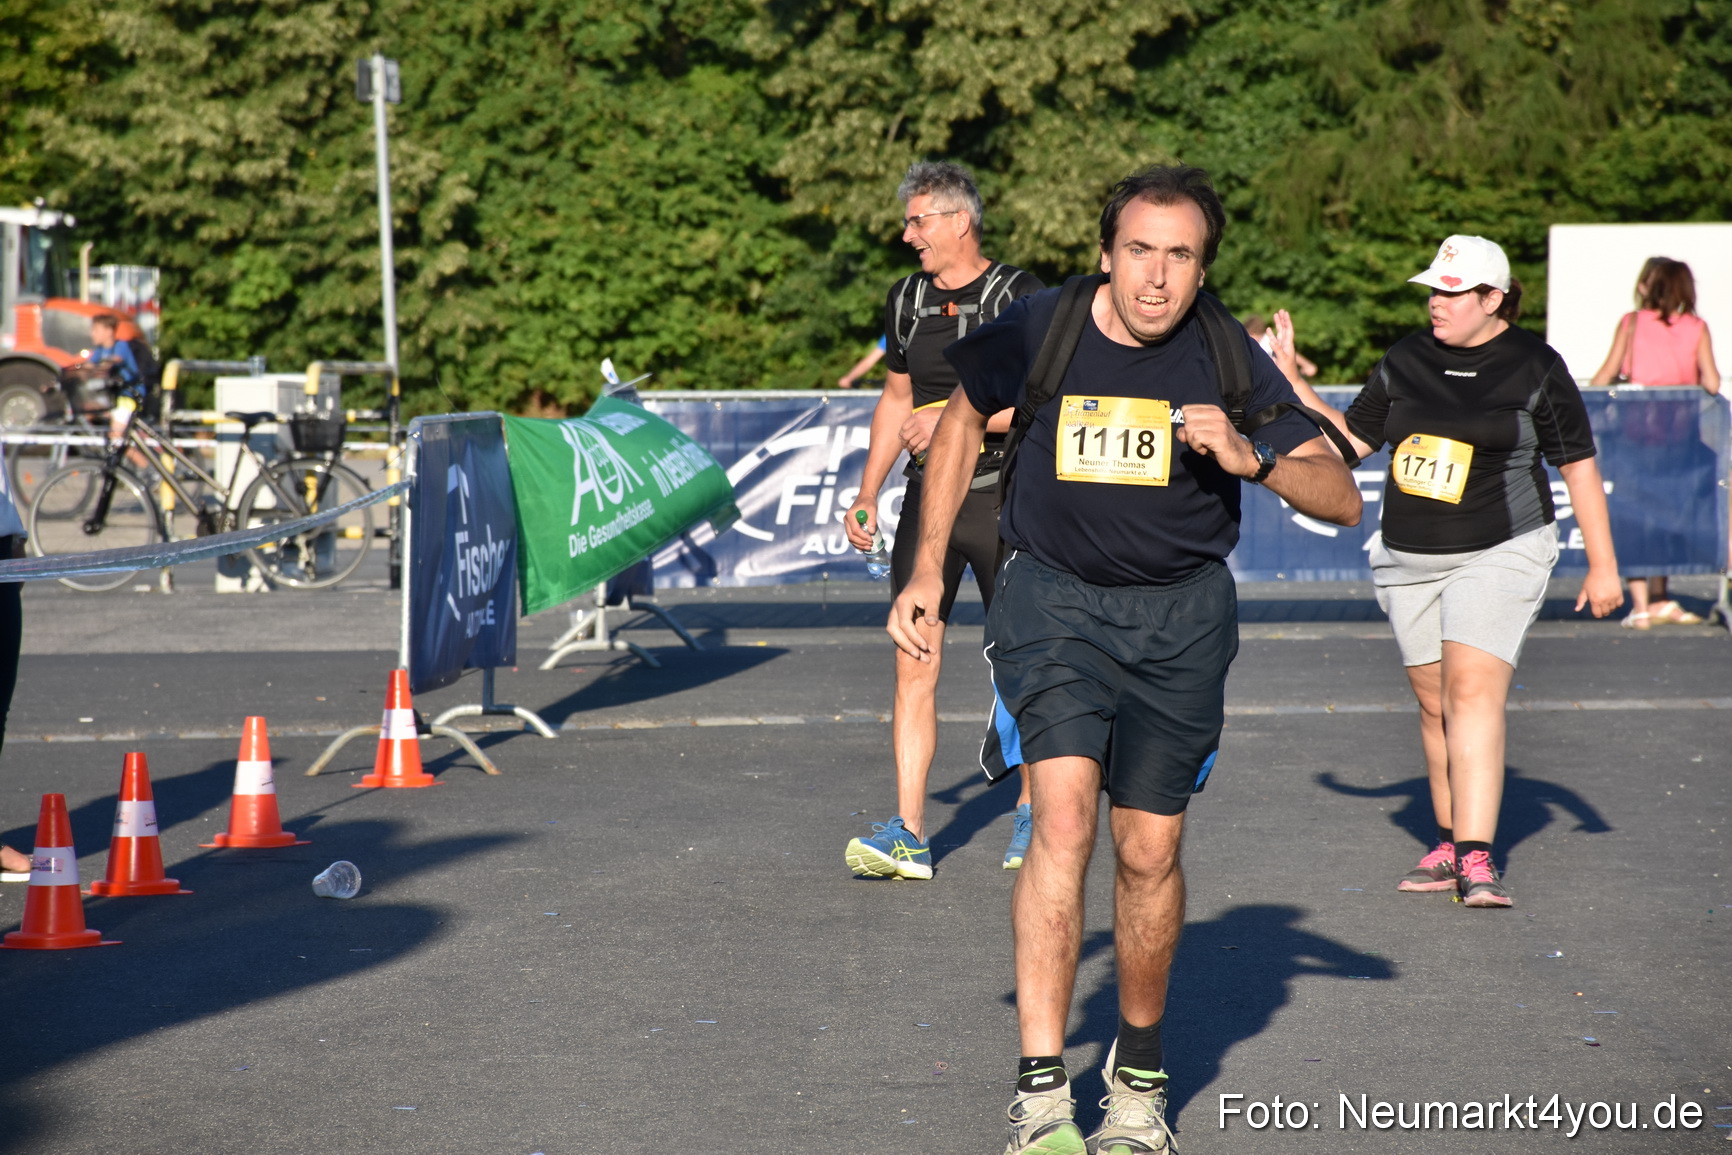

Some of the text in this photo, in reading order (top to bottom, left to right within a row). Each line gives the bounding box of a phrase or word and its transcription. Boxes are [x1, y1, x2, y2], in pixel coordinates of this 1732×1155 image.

[1073, 426, 1156, 460] 1118
[558, 419, 645, 527] AOK
[1074, 466, 1107, 474] Lebensh
[1112, 459, 1146, 469] Thomas
[1402, 454, 1455, 484] 1711
[775, 474, 908, 525] Fisc
[454, 523, 512, 599] Fische
[568, 531, 588, 559] Die
